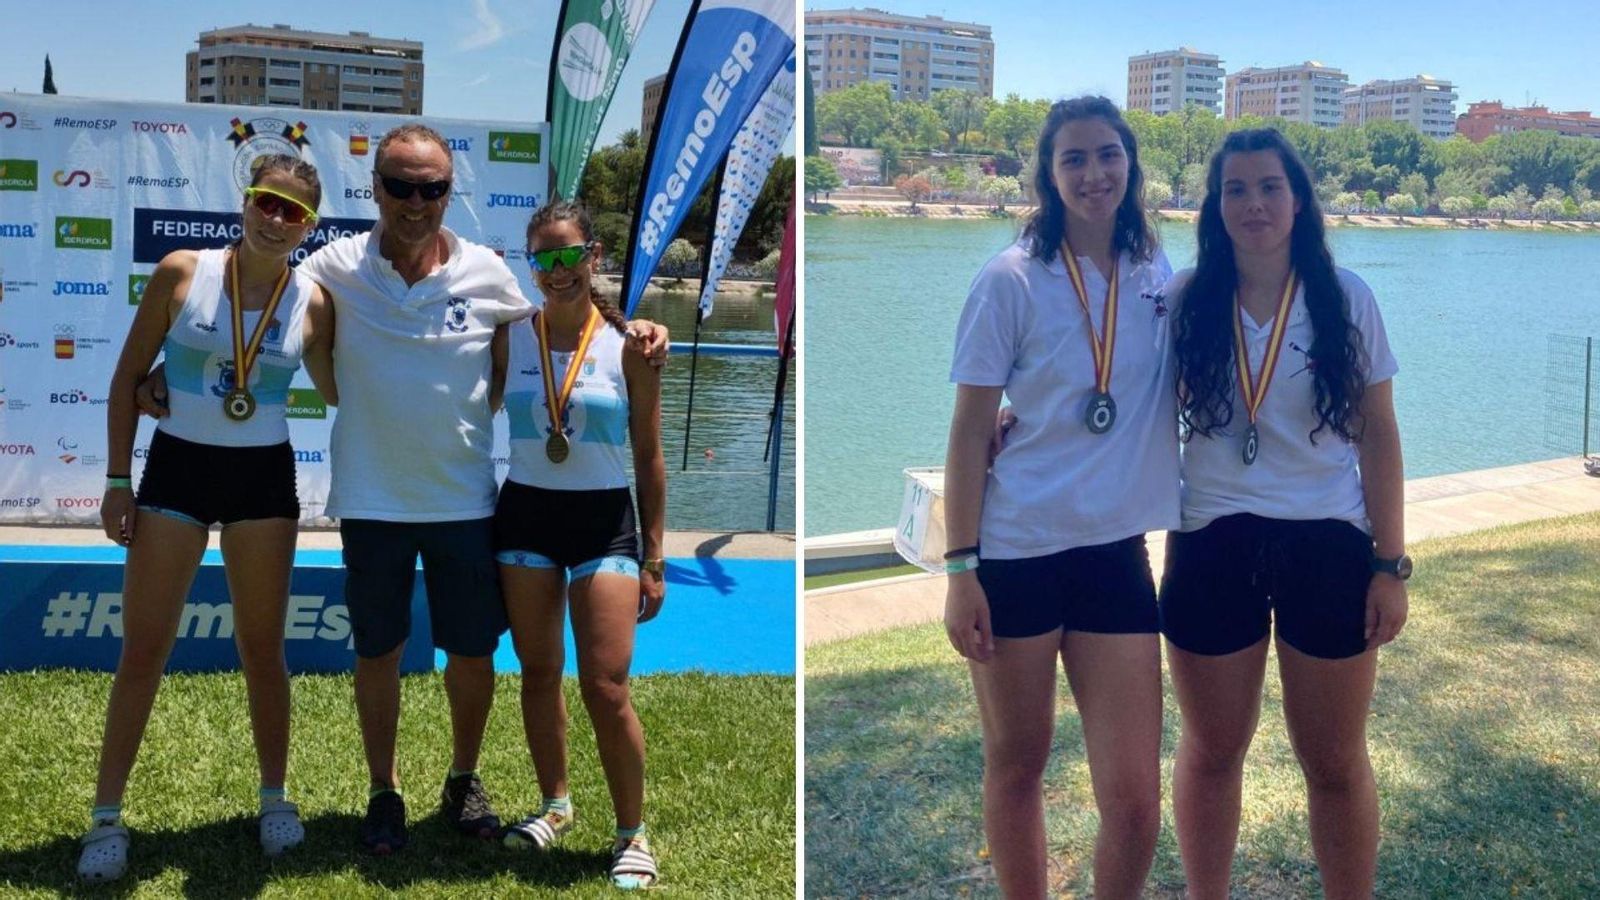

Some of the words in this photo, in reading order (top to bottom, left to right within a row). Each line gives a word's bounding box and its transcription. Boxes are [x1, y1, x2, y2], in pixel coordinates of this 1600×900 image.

[53, 117, 118, 130] #RemoESP
[132, 120, 187, 134] TOYOTA
[640, 31, 757, 256] #RemoEsp
[496, 151, 537, 159] IBERDROLA
[127, 175, 190, 188] #RemoESP
[344, 188, 373, 200] BCD
[64, 237, 108, 245] IBERDROLA
[50, 393, 79, 404] BCD
